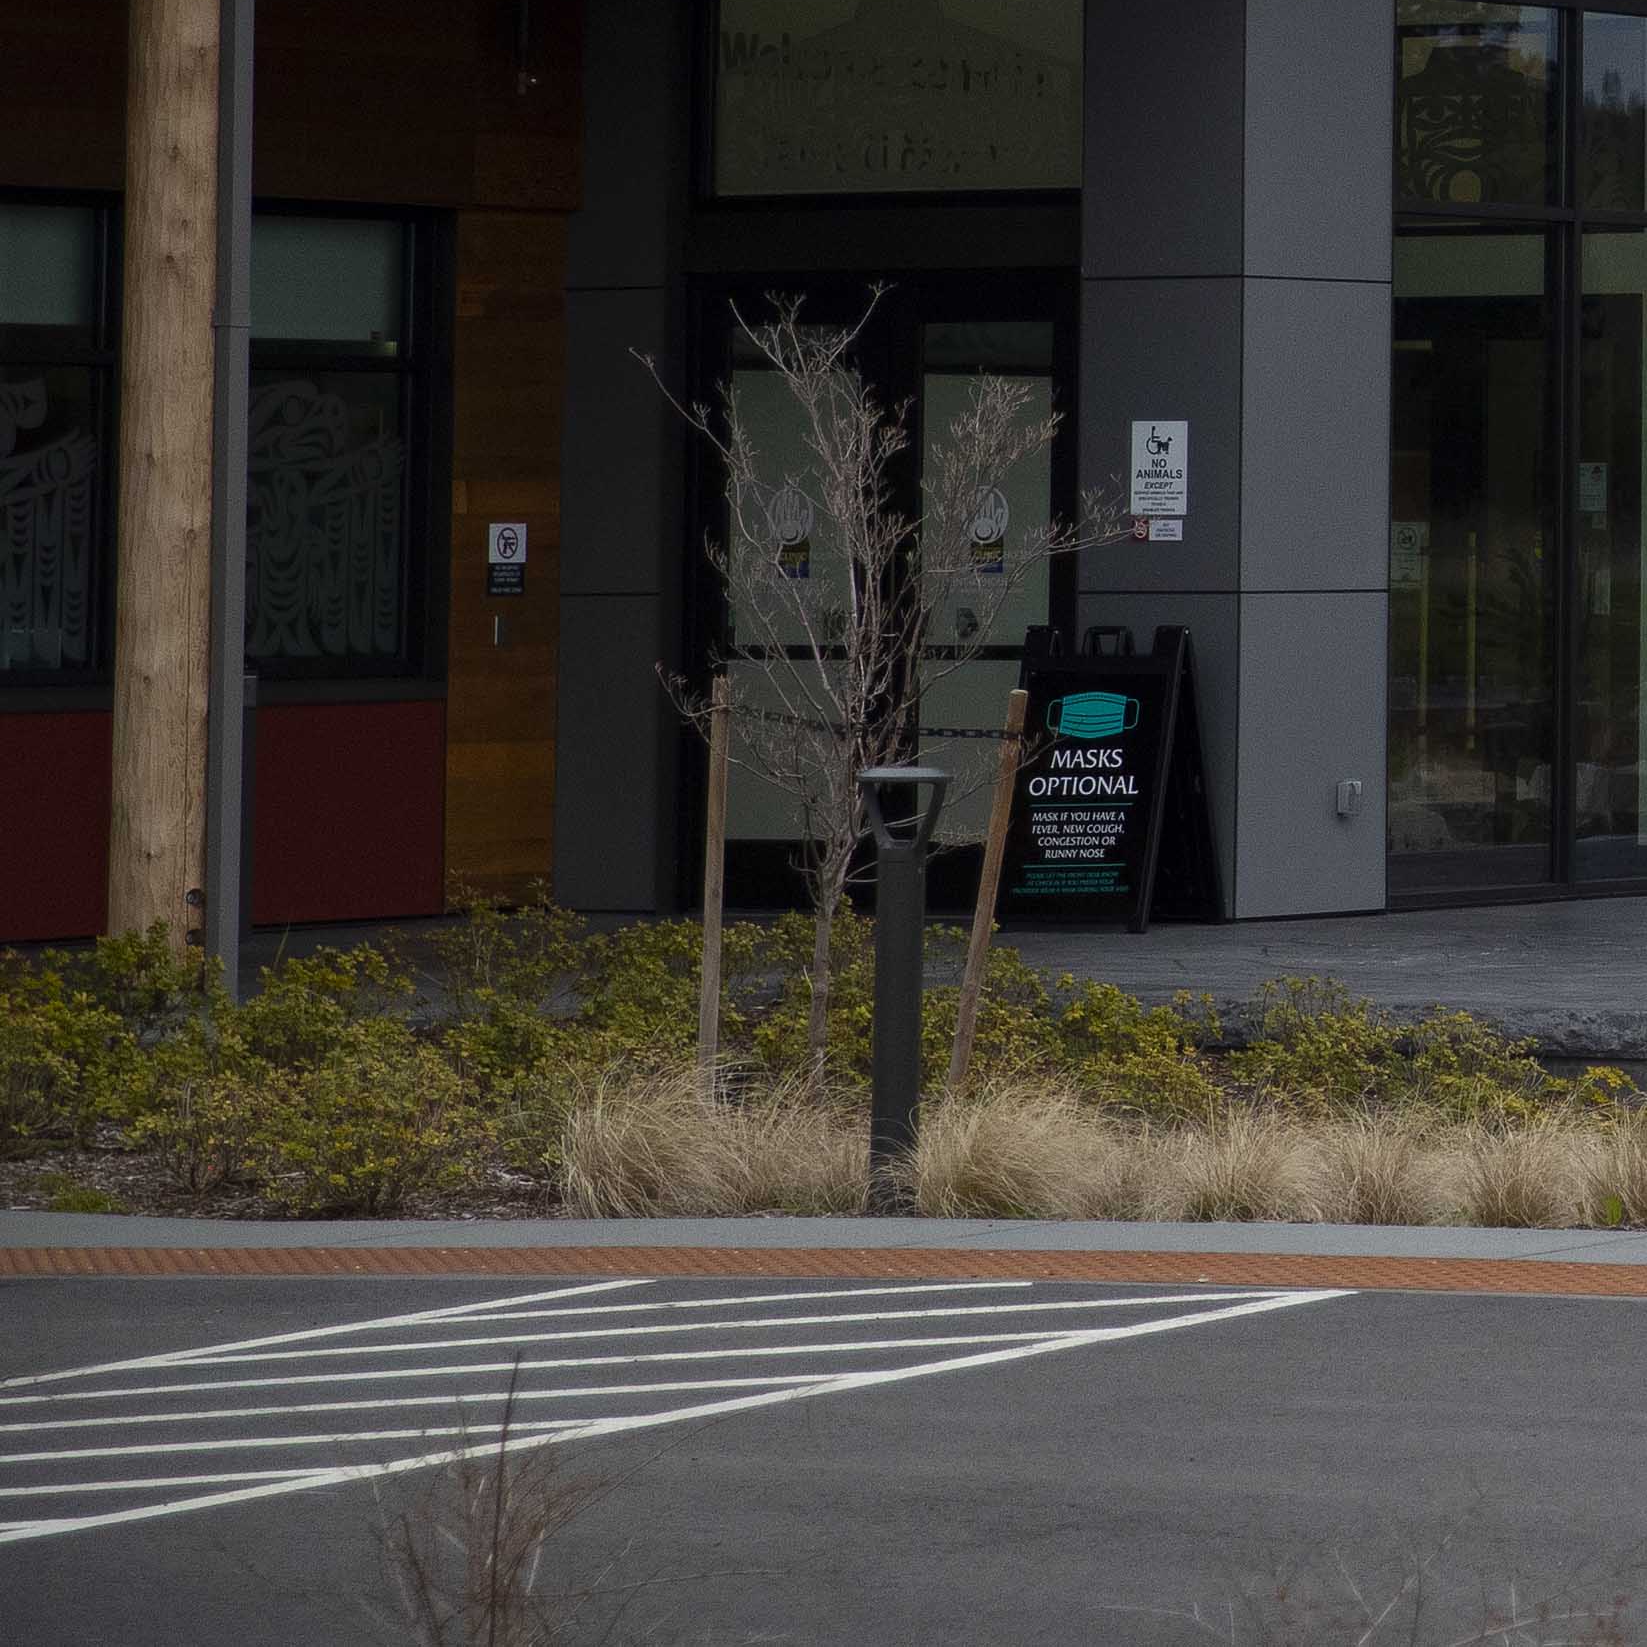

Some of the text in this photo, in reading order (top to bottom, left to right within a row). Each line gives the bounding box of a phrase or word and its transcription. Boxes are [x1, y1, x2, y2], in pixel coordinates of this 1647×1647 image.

[1152, 458, 1167, 468] NO
[1136, 469, 1183, 479] ANIMALS
[1050, 748, 1124, 769] MASKS
[1028, 775, 1139, 796] OPTIONAL
[1032, 811, 1126, 821] MASK IF YOU HAVE A
[1062, 824, 1085, 834] NEW
[1038, 836, 1116, 847] CONGESTION OR
[1044, 848, 1105, 859] RUNNY NOSE
